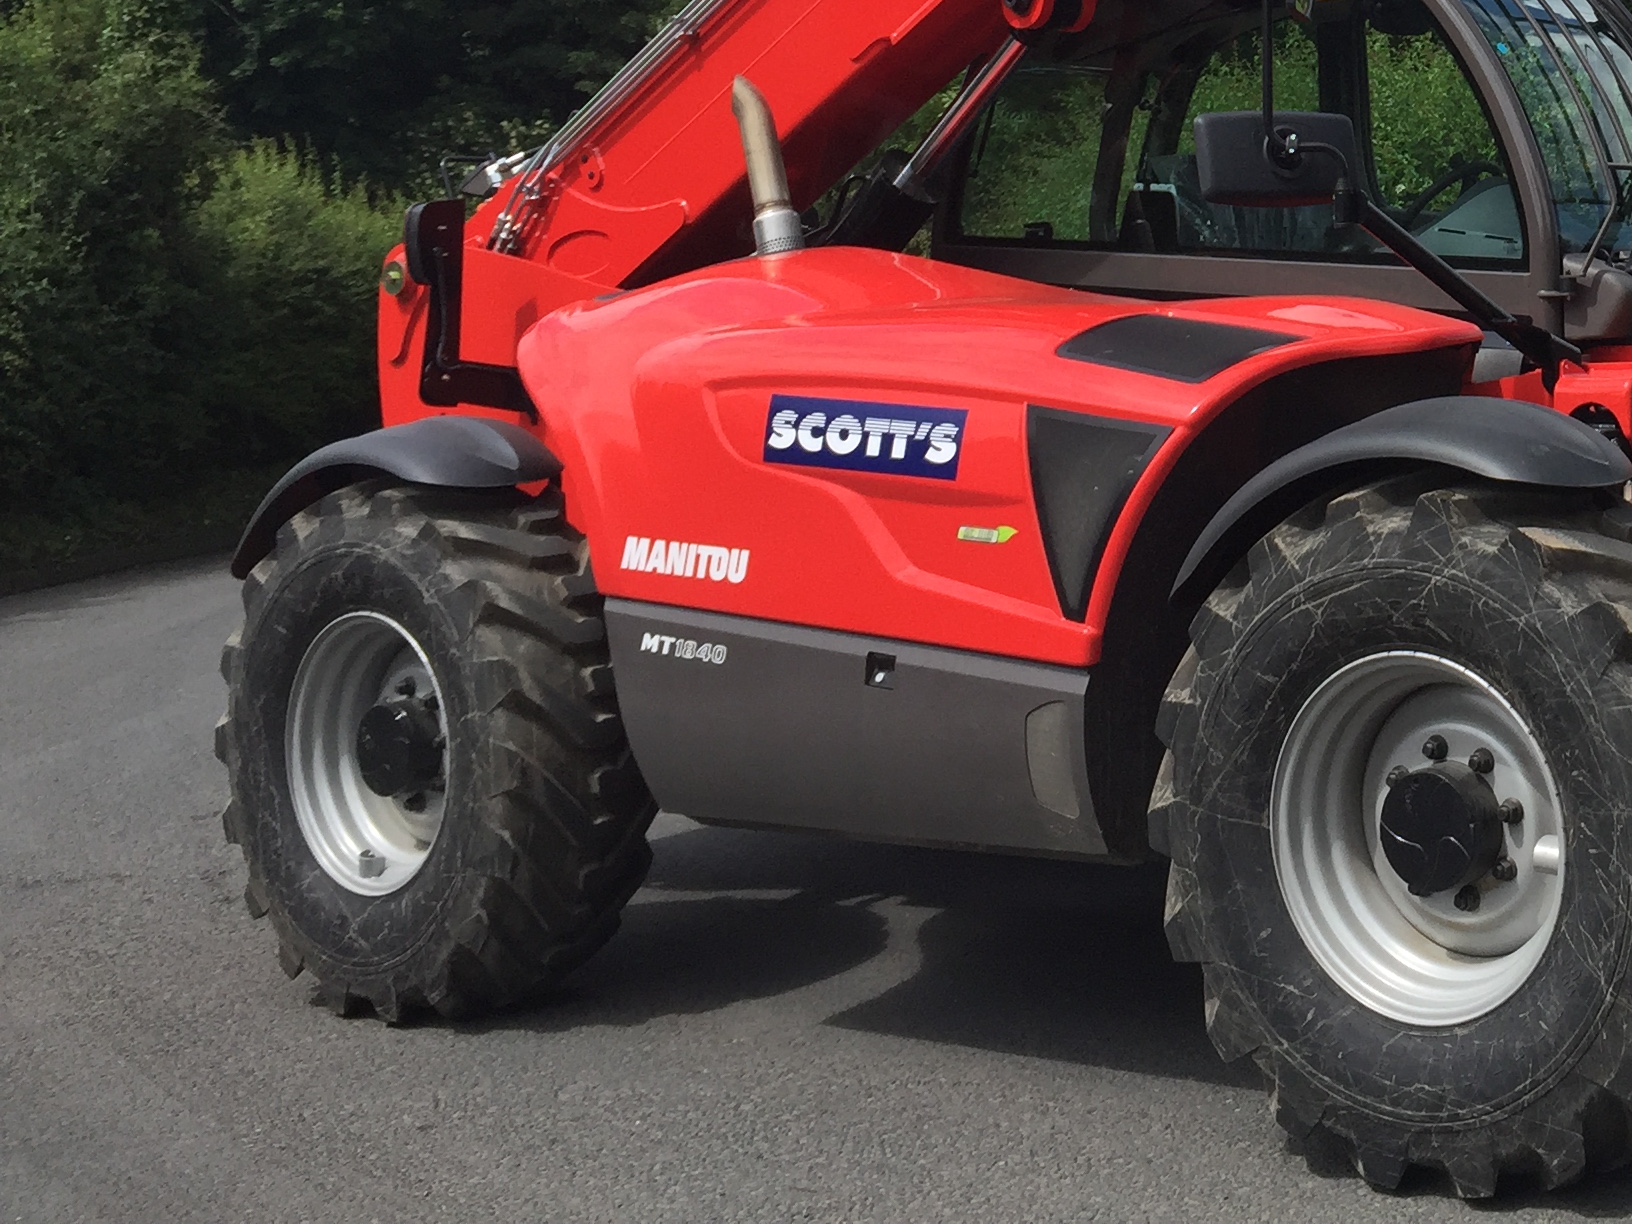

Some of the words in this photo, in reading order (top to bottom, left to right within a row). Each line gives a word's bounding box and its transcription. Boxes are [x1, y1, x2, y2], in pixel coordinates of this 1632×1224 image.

[767, 409, 959, 465] SCOTT'S
[620, 535, 750, 584] MANITOU
[640, 632, 727, 664] MT1840
